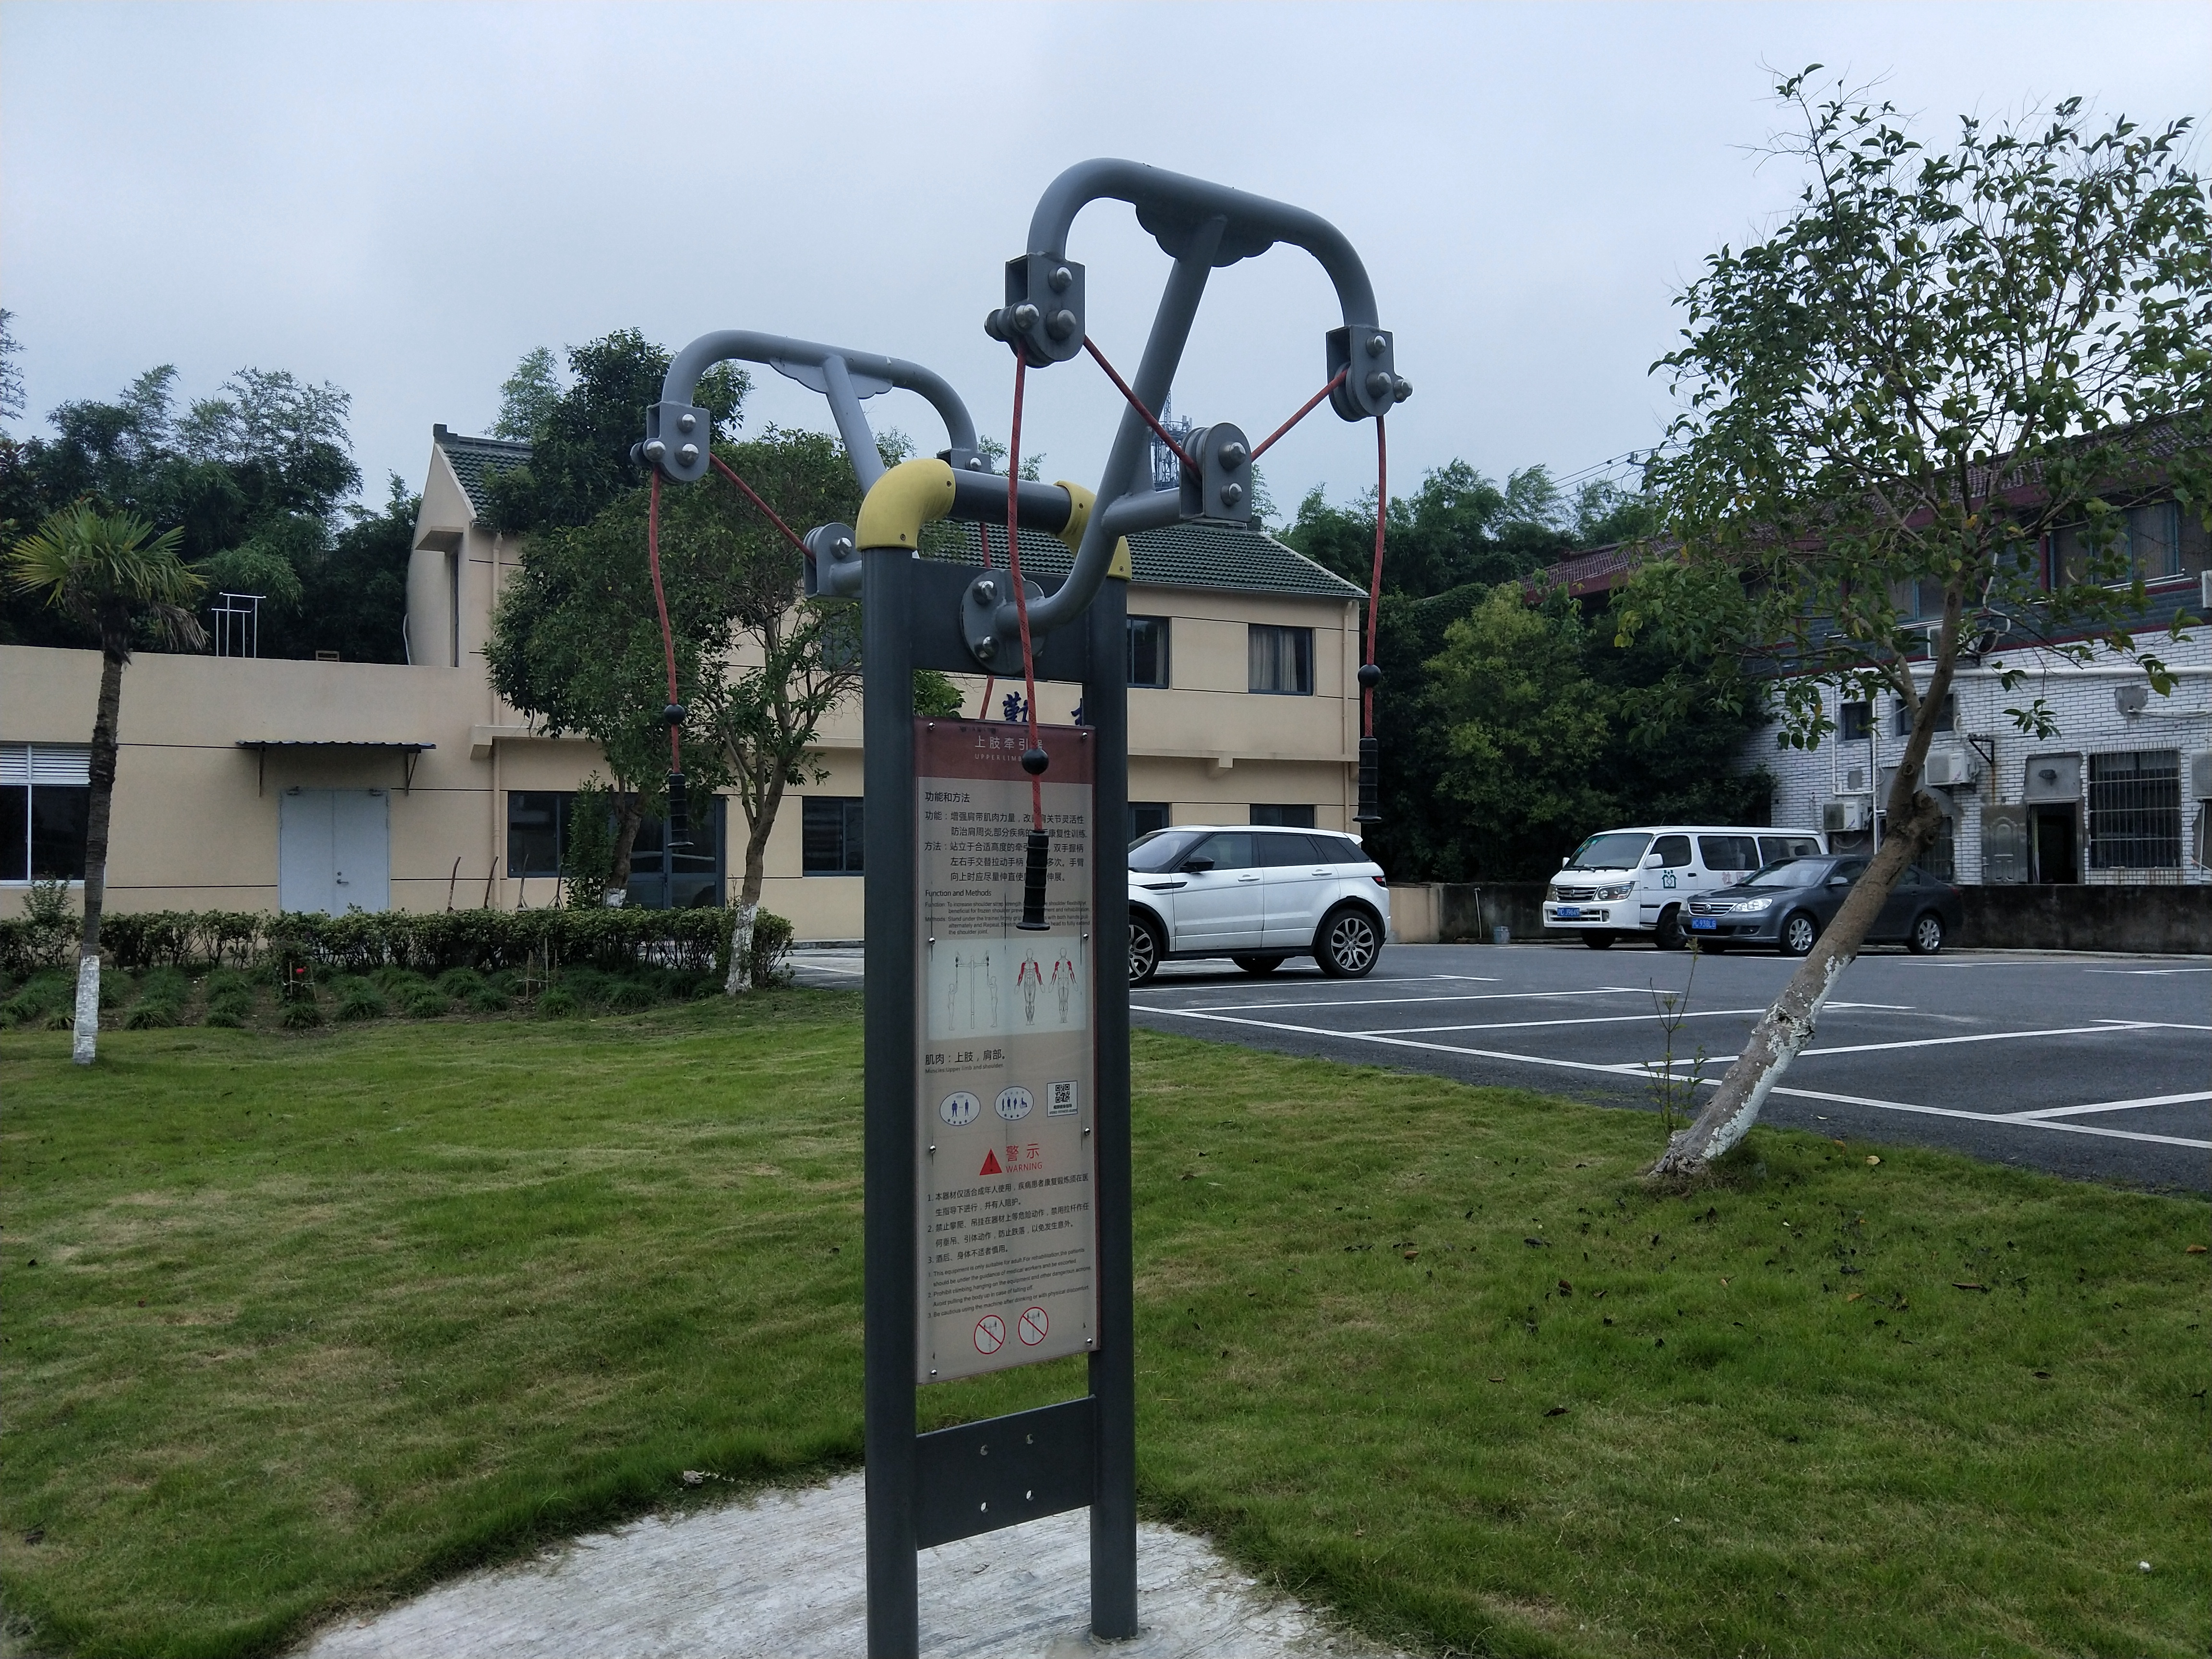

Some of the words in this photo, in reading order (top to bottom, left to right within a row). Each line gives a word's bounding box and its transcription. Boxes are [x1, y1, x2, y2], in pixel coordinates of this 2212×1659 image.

[925, 792, 970, 803] 功能和方法
[1006, 1162, 1043, 1173] WARNING
